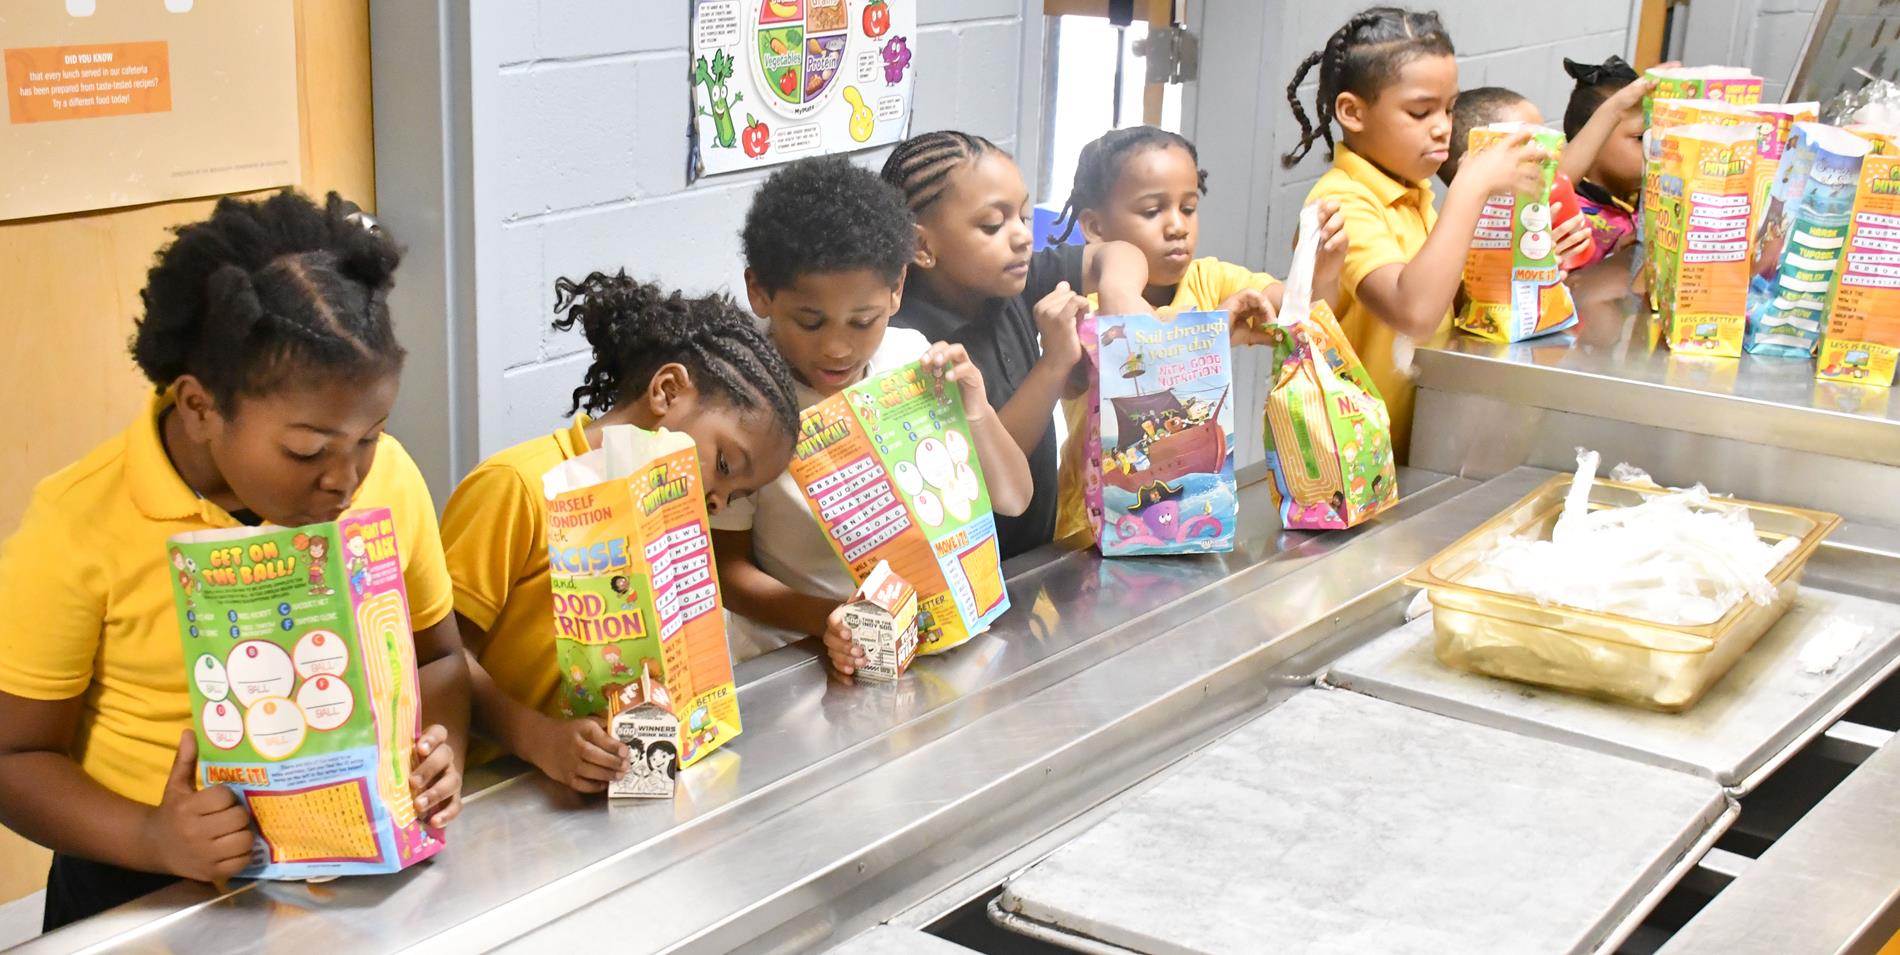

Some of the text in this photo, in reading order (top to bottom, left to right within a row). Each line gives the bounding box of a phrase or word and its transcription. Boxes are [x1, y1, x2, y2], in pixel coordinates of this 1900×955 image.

[64, 53, 112, 64] DID YOU KNOW
[765, 52, 802, 69] Vegetables
[808, 56, 836, 70] Protein
[30, 66, 148, 82] that every lunch served in our cafeteria
[20, 77, 159, 96] has been prepared from taste-tested recipes?
[52, 98, 62, 110] Try
[68, 96, 95, 107] different
[96, 96, 110, 104] food
[111, 94, 130, 106] today!
[1516, 270, 1544, 280] MOVE
[1136, 318, 1224, 344] Sail through
[1149, 336, 1216, 360] your day
[1191, 354, 1221, 368] GOOD
[210, 542, 278, 568] GET ON
[548, 538, 626, 572] RCISE
[202, 556, 296, 586] THE BALL!
[552, 593, 602, 617] OOD
[556, 612, 641, 641] RITION
[248, 684, 270, 694] BALL
[696, 688, 728, 707] BETTER
[316, 709, 340, 718] BALL
[208, 766, 245, 783] MOVE
[246, 768, 270, 786] IT!
